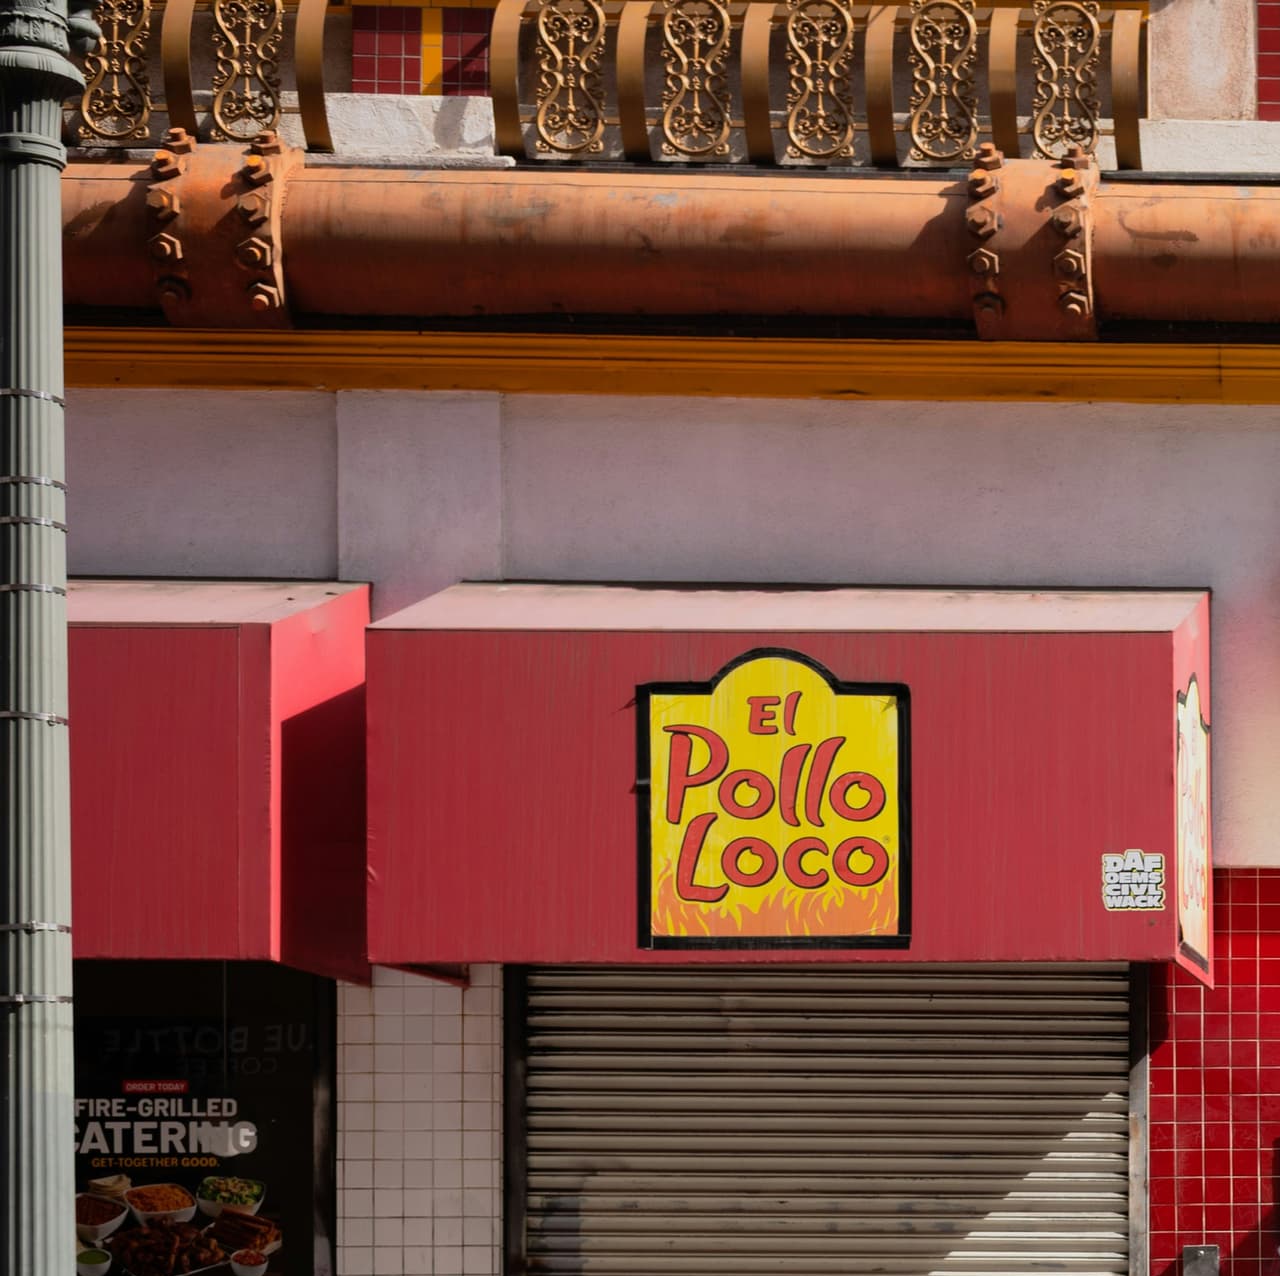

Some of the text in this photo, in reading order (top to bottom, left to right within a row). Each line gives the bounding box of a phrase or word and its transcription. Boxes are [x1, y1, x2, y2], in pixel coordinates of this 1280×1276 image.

[746, 690, 804, 736] El
[662, 723, 887, 829] Pollo
[675, 810, 891, 905] Loco
[1104, 850, 1163, 873] DAF
[1105, 883, 1163, 896] CIVL
[1105, 895, 1163, 909] WACK
[125, 1082, 186, 1092] ORDER TODAY
[75, 1098, 238, 1118] FIRE-GRILLED
[75, 1120, 258, 1154] ATERING
[91, 1157, 221, 1168] GET-TOGETHER GOOD.
